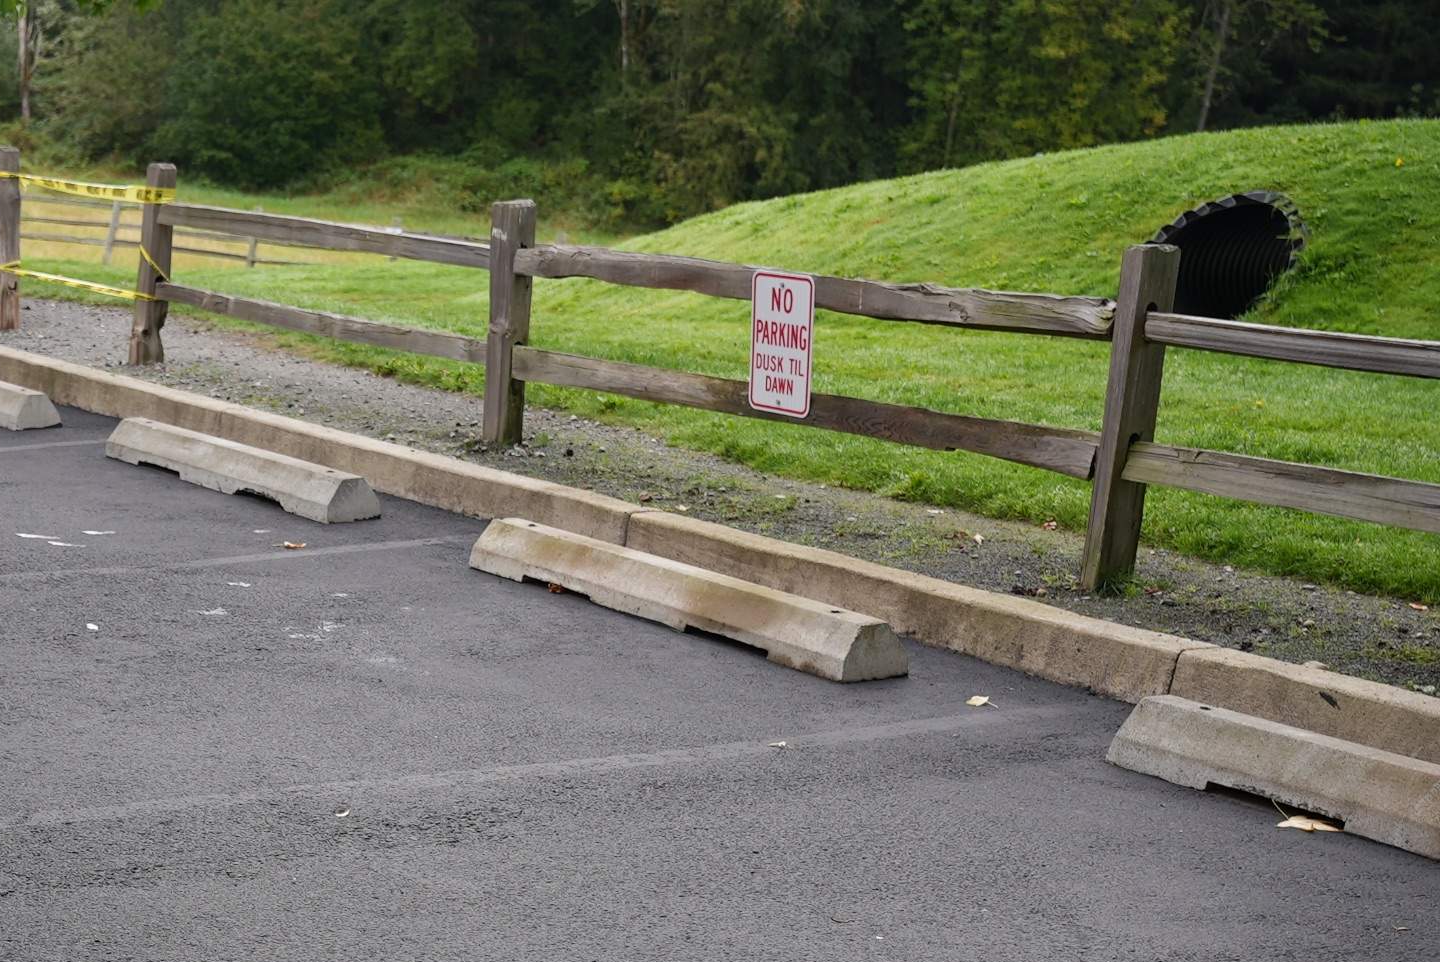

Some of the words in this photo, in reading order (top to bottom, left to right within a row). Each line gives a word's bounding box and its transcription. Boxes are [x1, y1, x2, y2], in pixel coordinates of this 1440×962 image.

[771, 287, 793, 313] NO
[756, 319, 807, 350] PARKING
[756, 352, 784, 373] DUSK
[789, 358, 804, 377] TIL
[765, 375, 793, 396] DAWN
